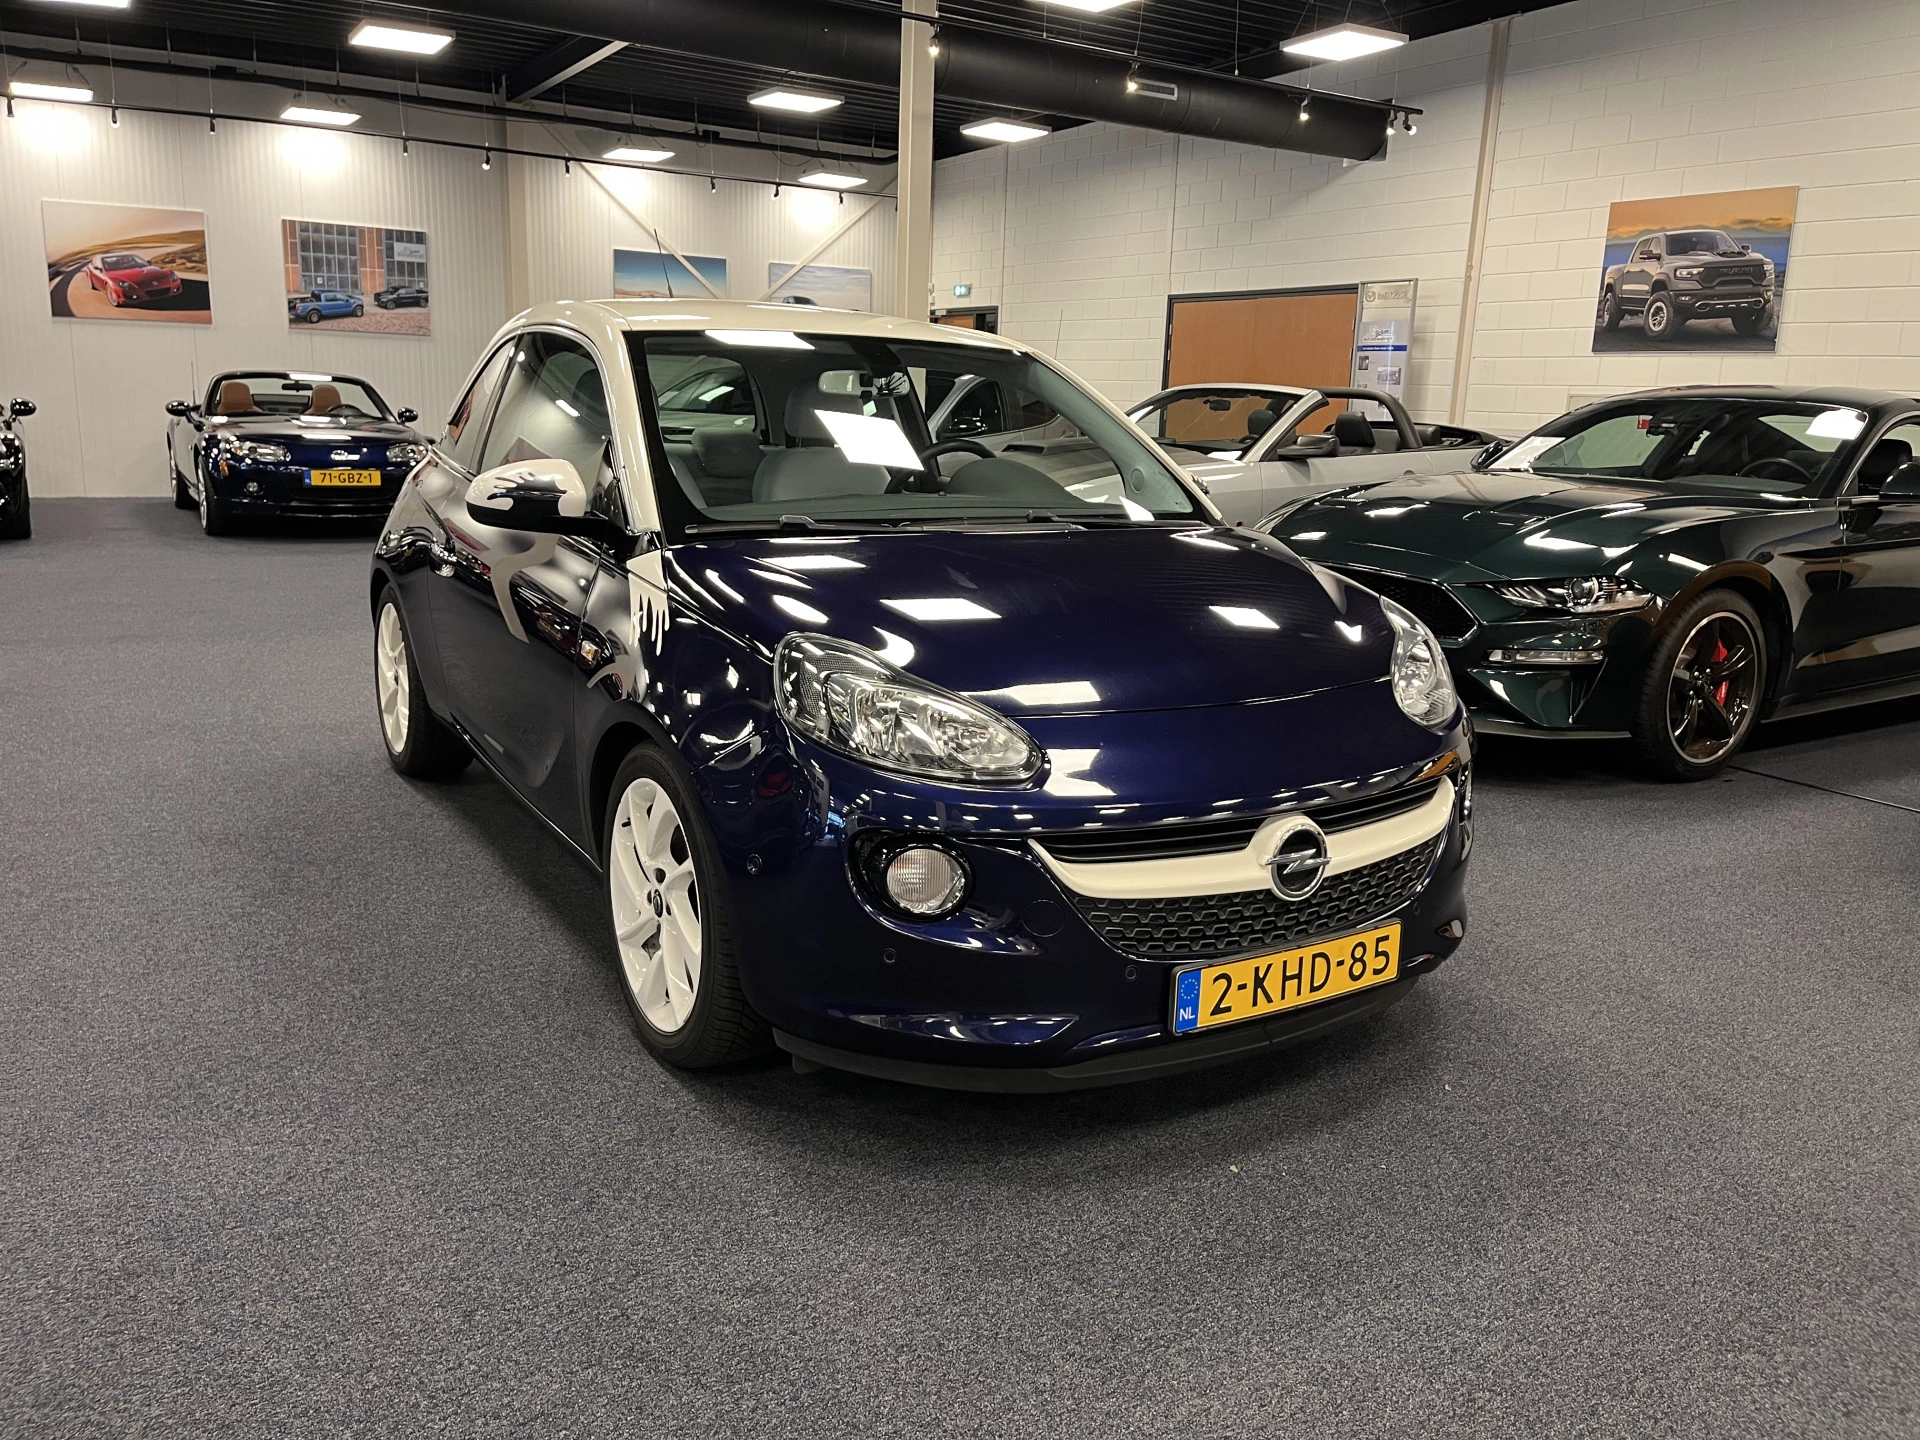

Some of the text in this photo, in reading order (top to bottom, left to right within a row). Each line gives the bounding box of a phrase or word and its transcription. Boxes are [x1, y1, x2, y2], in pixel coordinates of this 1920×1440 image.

[319, 472, 372, 484] 71-GBZ-1
[1209, 934, 1391, 1017] 2-KHD-85
[1179, 1005, 1196, 1022] NL
